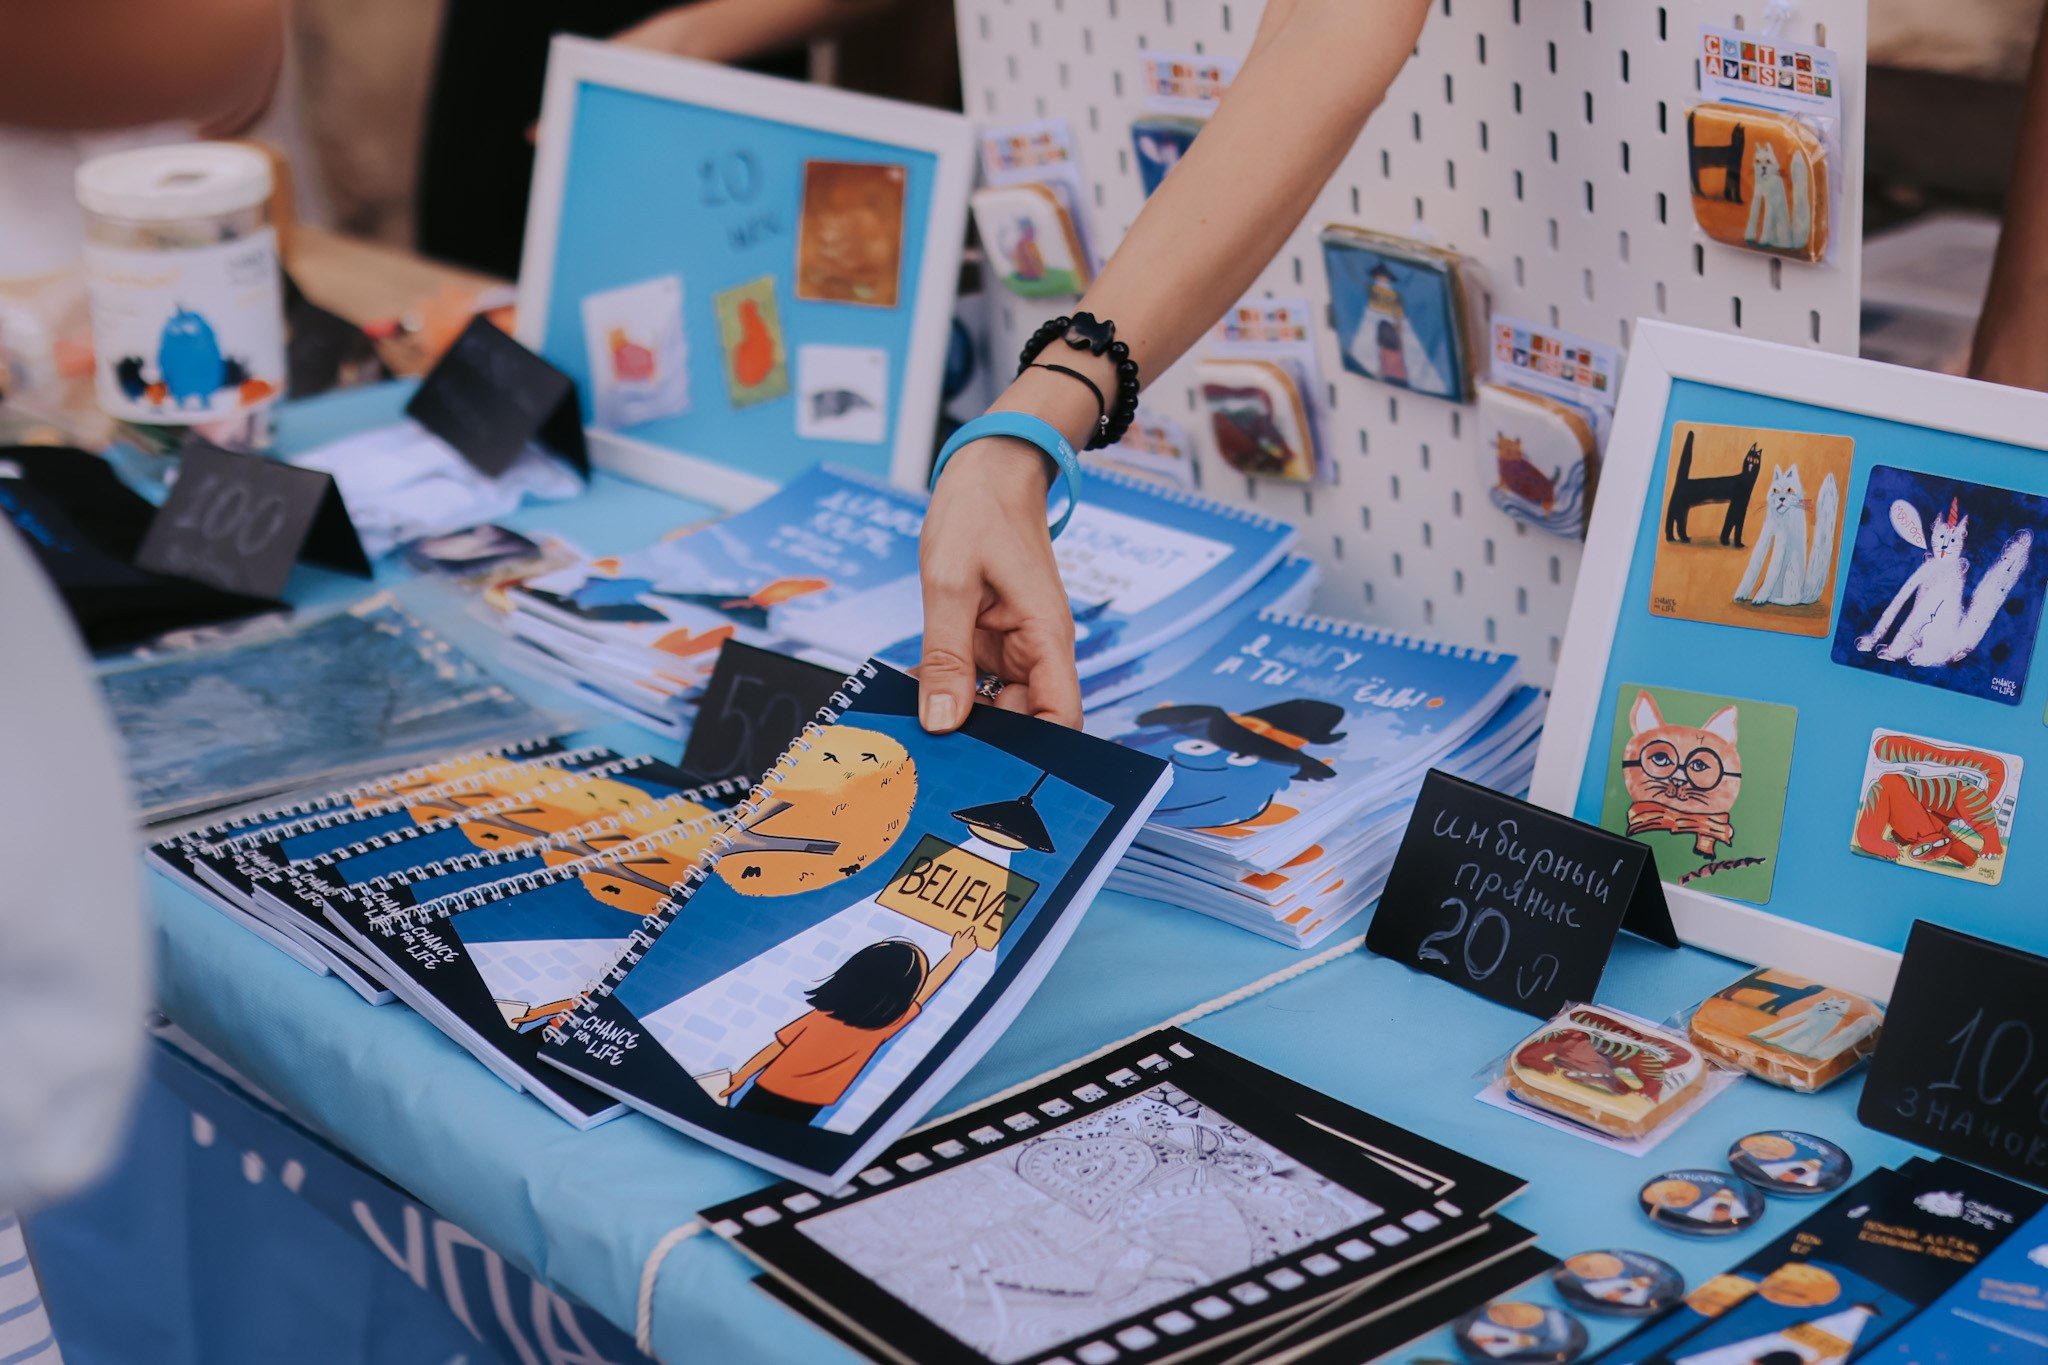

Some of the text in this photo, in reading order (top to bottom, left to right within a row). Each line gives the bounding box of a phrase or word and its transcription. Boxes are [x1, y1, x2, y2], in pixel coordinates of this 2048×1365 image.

[176, 474, 286, 557] 100
[1991, 677, 2017, 690] CHANCE
[1998, 686, 2016, 697] LIFE
[897, 855, 1022, 933] BELIEVE
[1454, 862, 1582, 929] пряник
[399, 931, 441, 970] FOR LIFE
[411, 926, 460, 963] CHANCE
[1417, 897, 1512, 982] 20
[572, 1029, 625, 1067] FOR LIFE
[582, 1015, 640, 1050] CHANCE
[1926, 1006, 2035, 1106] 10
